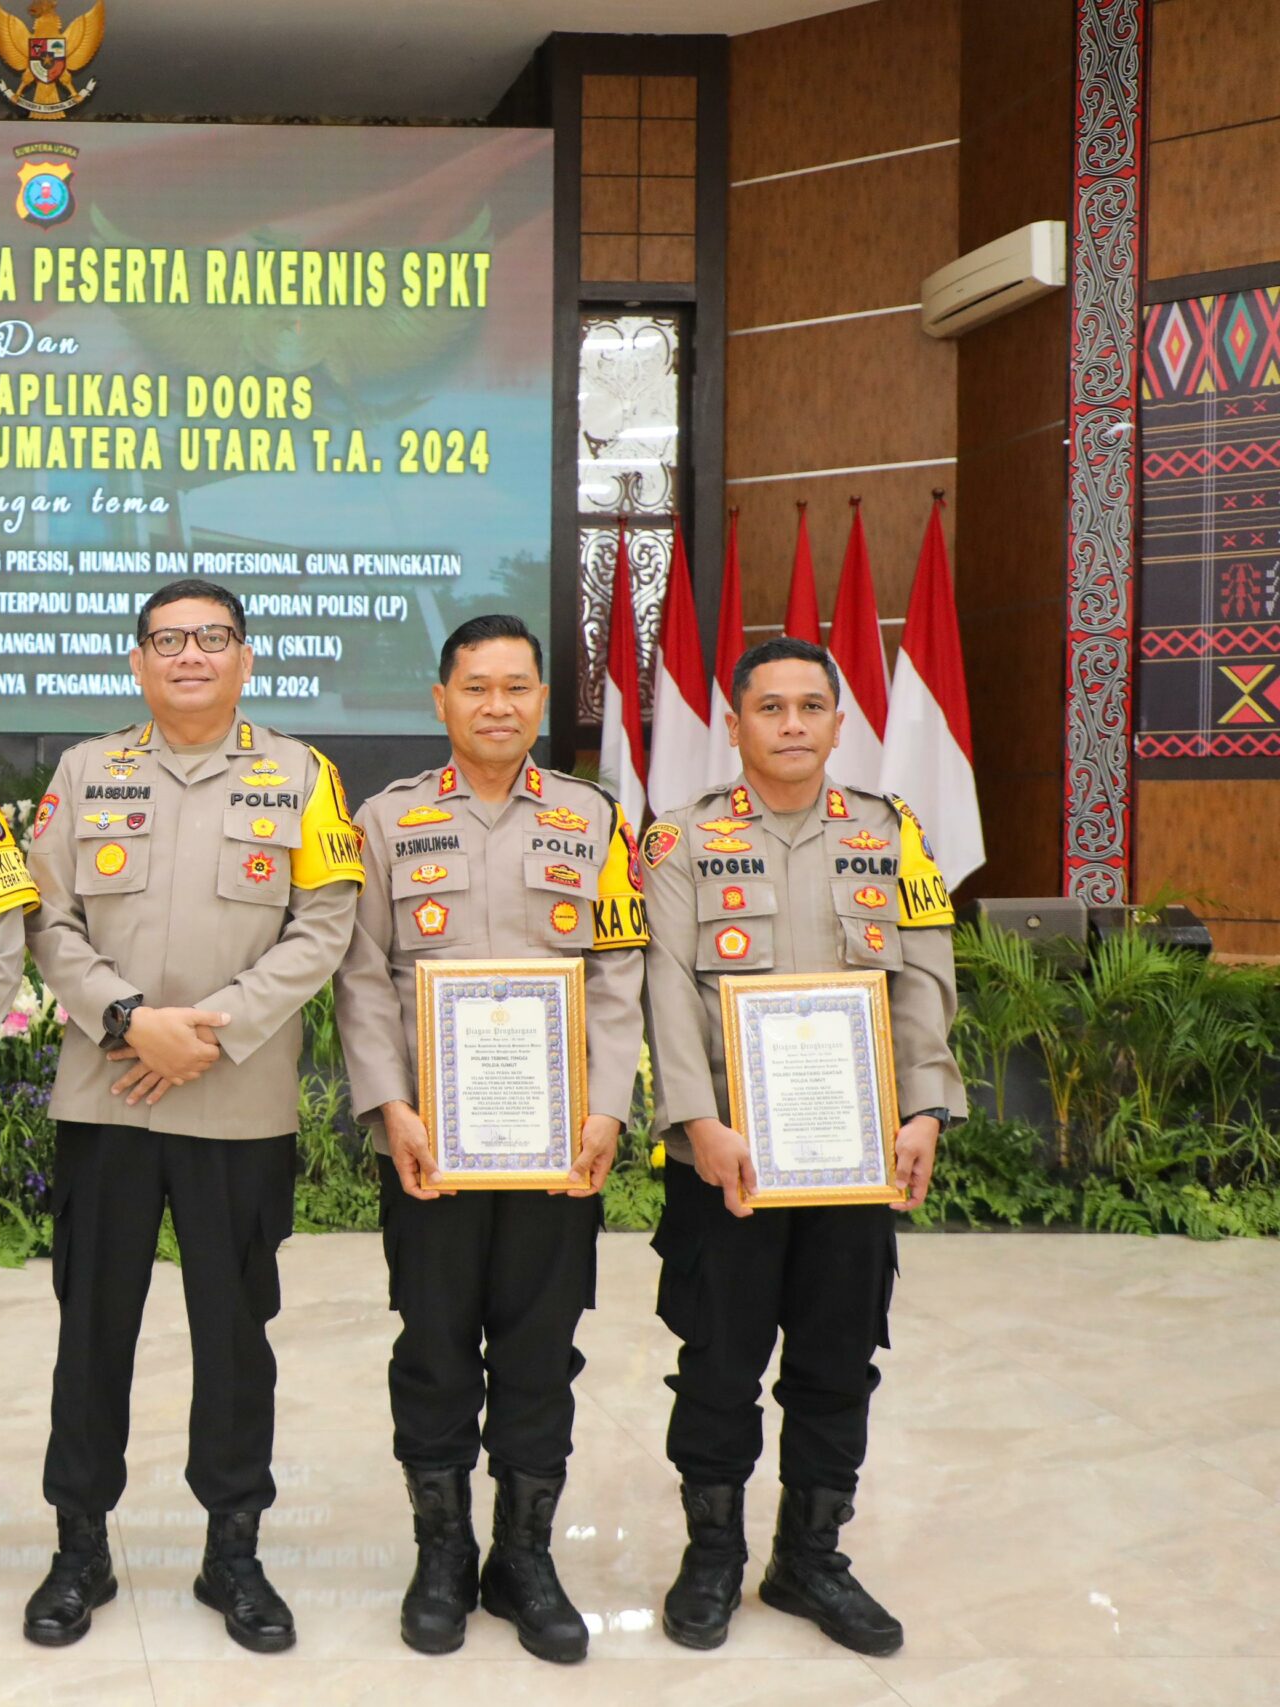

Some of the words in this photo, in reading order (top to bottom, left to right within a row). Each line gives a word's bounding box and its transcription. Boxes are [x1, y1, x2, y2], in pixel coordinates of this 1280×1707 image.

[33, 248, 190, 304] PESERTA
[206, 250, 387, 307] RAKERNIS
[401, 252, 491, 308] SPKT
[186, 376, 313, 420] DOORS
[179, 428, 297, 472] UTARA
[313, 430, 382, 473] T.A.
[399, 429, 490, 474] 2024
[91, 487, 170, 514] tema
[6, 551, 74, 575] PRESISI,
[79, 552, 150, 573] HUMANIS
[156, 553, 188, 573] DAN
[193, 554, 302, 575] PROFESIONAL
[306, 554, 349, 576] GUNA
[353, 554, 462, 576] PENINGKATAN
[76, 593, 130, 614] DALAM
[241, 595, 312, 616] LAPORAN
[318, 596, 369, 617] POLISI
[374, 596, 409, 621] (LP)
[60, 633, 113, 655] TANDA
[278, 635, 343, 661] (SKTLK)
[36, 674, 142, 696] PENGAMANAN
[276, 676, 320, 698] 2024
[85, 785, 151, 800] MASBUDHI
[231, 792, 298, 810] POLRI
[532, 838, 594, 860] POLRI
[697, 858, 765, 877] YOGEN
[836, 858, 898, 876] POLRI
[909, 878, 936, 913] KA
[593, 898, 624, 938] KA
